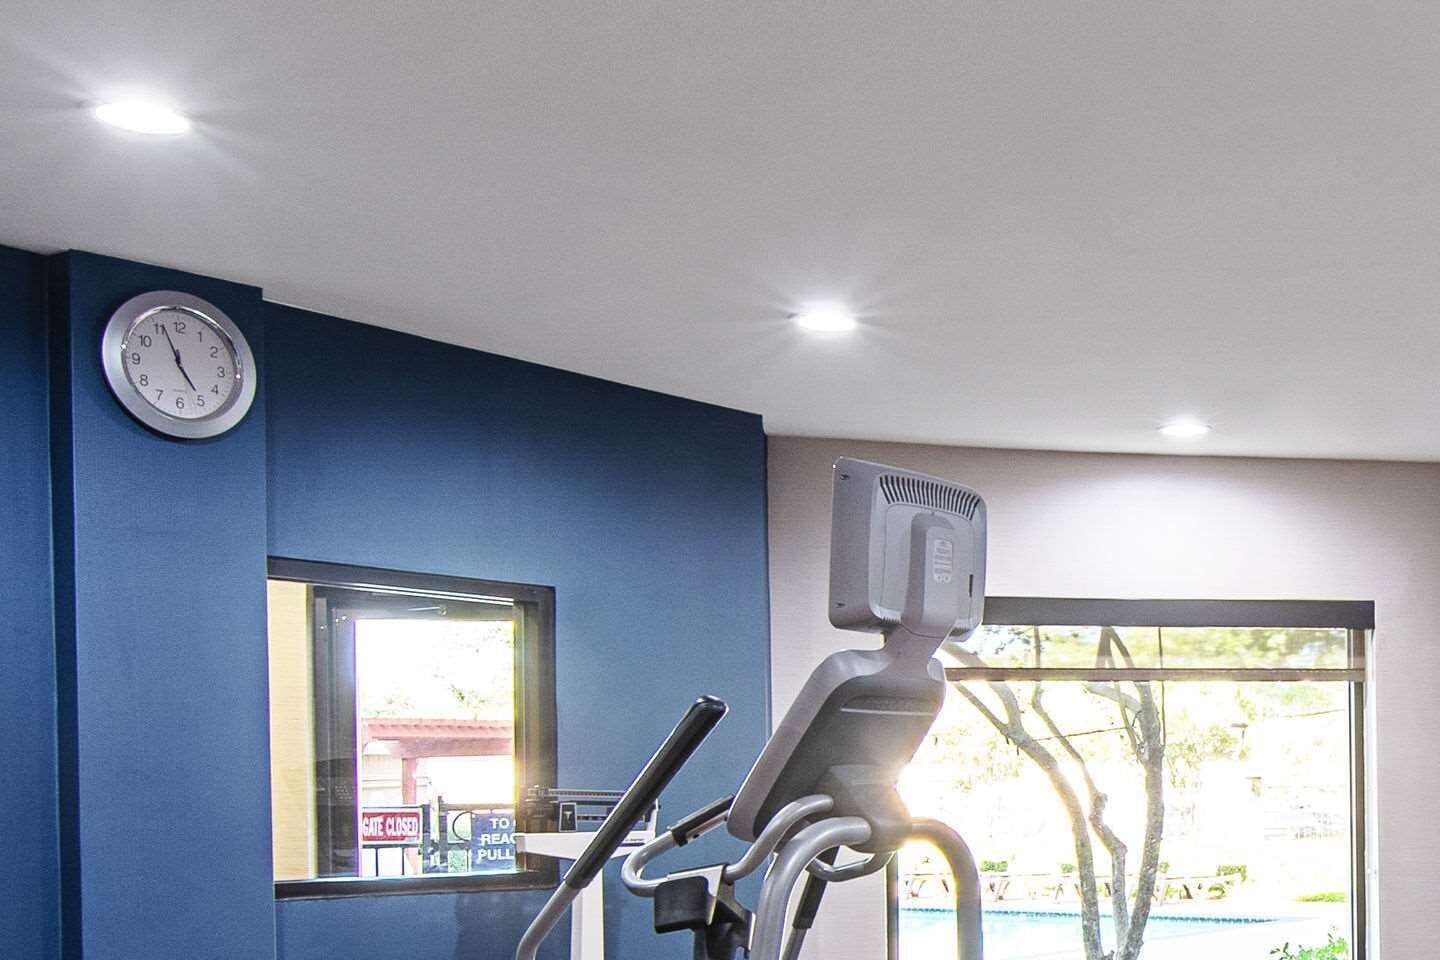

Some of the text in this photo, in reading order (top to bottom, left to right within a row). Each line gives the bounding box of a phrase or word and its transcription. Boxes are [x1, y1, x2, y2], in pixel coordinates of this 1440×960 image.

[153, 323, 165, 335] 11
[173, 321, 186, 334] 12
[138, 335, 152, 347] 10
[209, 346, 218, 358] 2
[131, 352, 140, 365] 9
[216, 366, 225, 378] 3
[139, 374, 149, 386] 8
[155, 389, 164, 400] 7
[210, 384, 219, 395] 4
[175, 397, 185, 409] 6
[196, 394, 205, 407] 5
[362, 815, 419, 836] GATE CLOSED
[489, 817, 510, 829] TO
[476, 848, 515, 864] PULL
